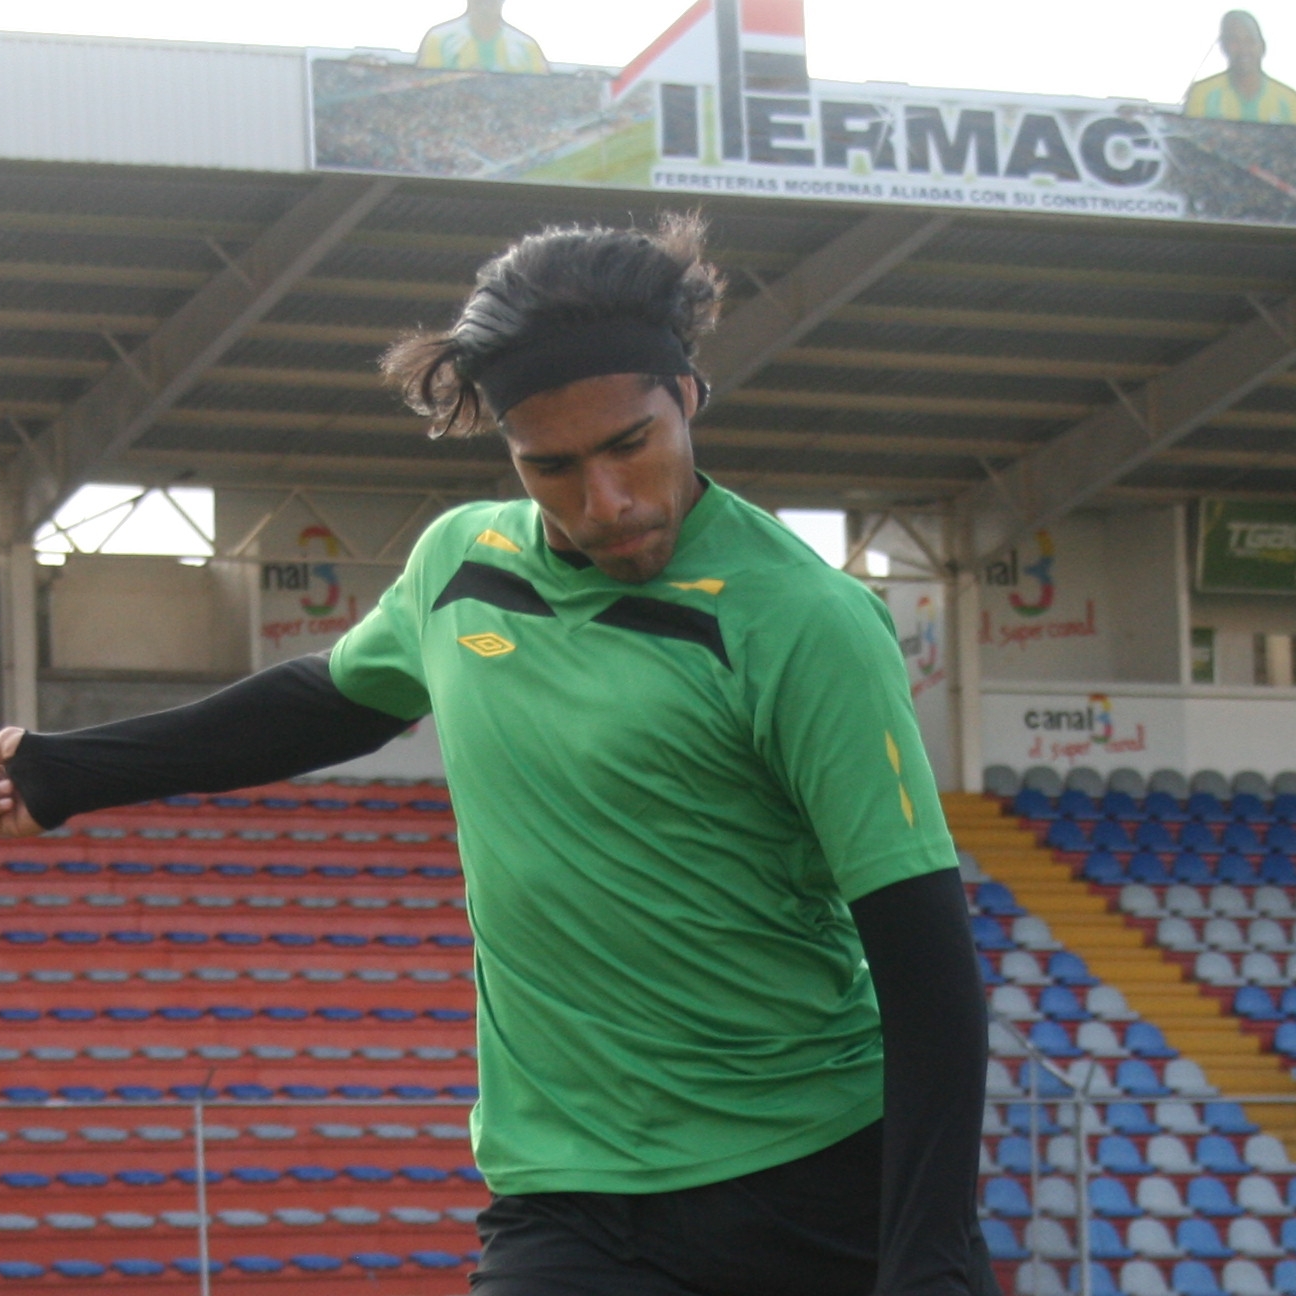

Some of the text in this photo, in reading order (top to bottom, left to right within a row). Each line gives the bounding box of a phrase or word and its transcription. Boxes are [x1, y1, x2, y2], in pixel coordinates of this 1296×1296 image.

[654, 171, 779, 192] FERRETERIAS
[784, 179, 883, 197] MODERNAS
[890, 186, 964, 201] ALIADAS
[970, 190, 1006, 203] CON
[1013, 193, 1035, 206] SU
[1024, 705, 1094, 731] canal
